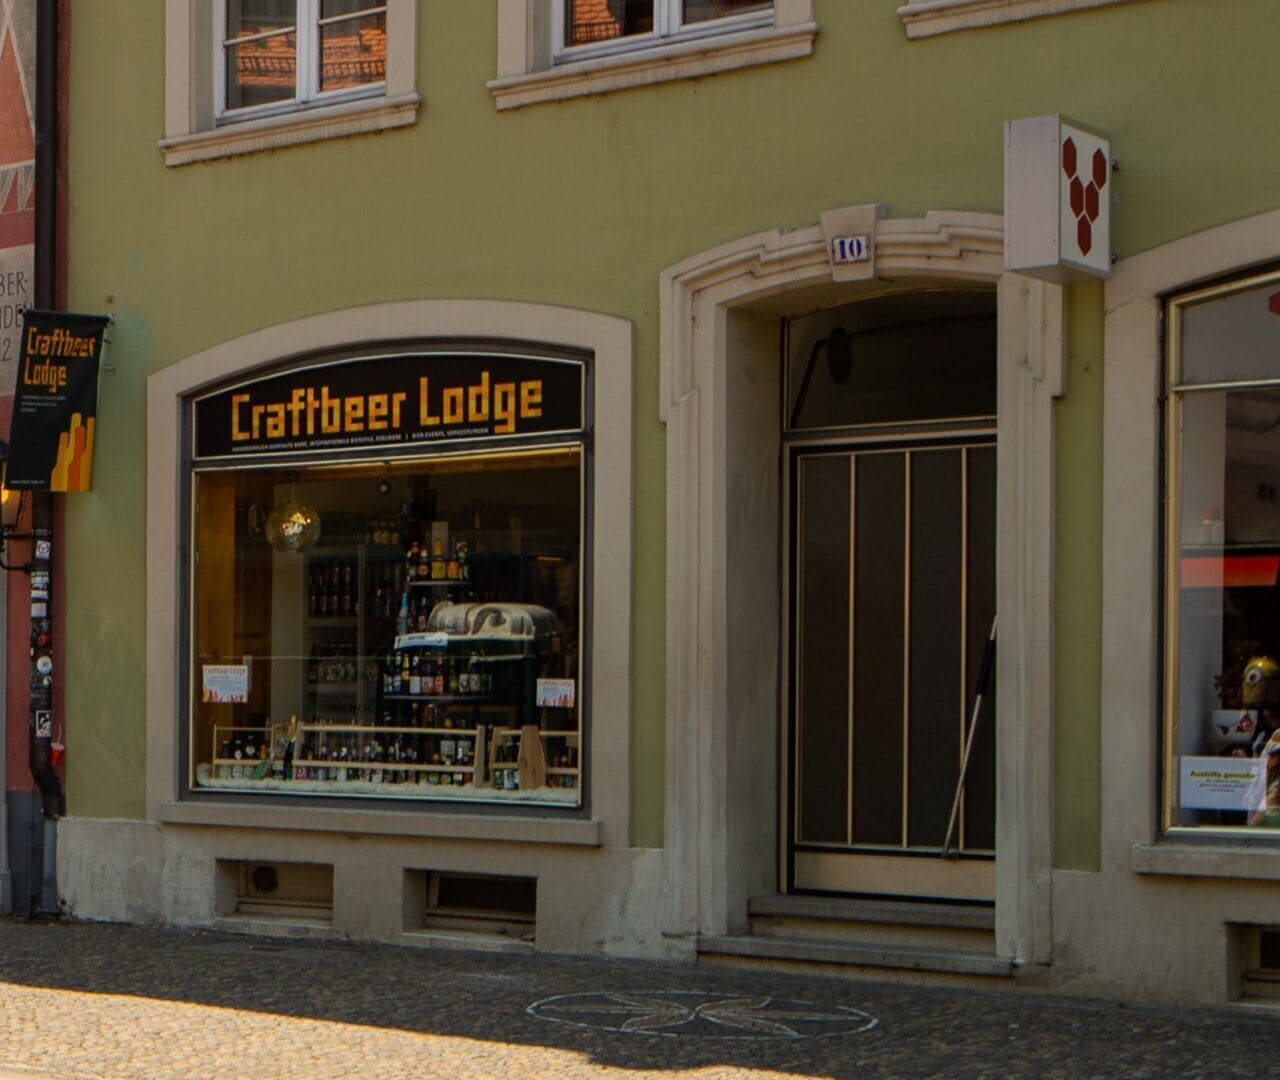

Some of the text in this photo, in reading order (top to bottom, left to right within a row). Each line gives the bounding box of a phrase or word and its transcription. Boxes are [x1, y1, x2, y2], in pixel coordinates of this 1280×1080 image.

[839, 238, 862, 260] 10
[26, 326, 95, 358] Craftbeer
[23, 357, 67, 393] Lodge
[232, 371, 542, 441] Craftbeer Lodge
